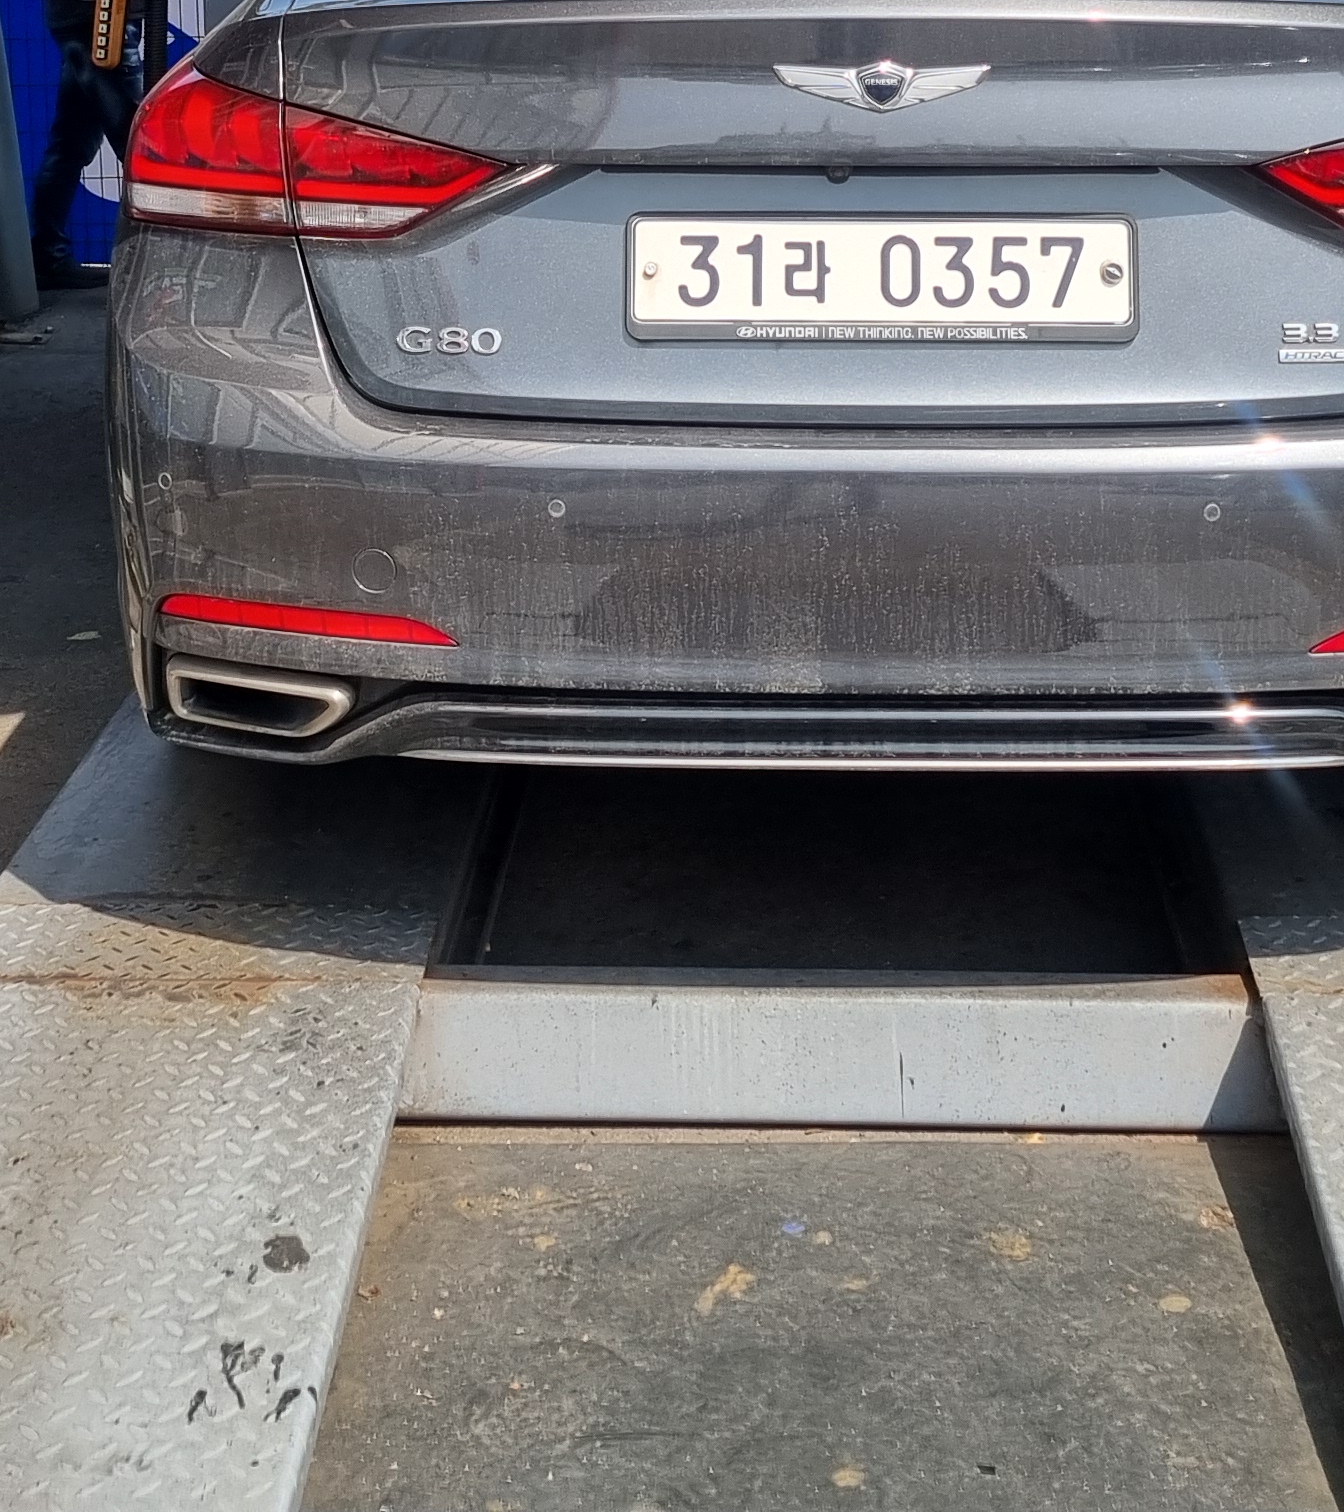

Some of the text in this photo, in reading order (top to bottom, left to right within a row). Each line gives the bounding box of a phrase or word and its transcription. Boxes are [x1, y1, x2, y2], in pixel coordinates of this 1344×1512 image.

[864, 78, 899, 86] GENESIS
[677, 234, 1085, 308] 31라 0357
[396, 326, 502, 354] G80
[756, 326, 1028, 339] HYUNDAI NEW THINKING. NEW POSSIBILITIES.
[1282, 322, 1339, 343] 3.3
[1284, 351, 1344, 359] HTRAC
